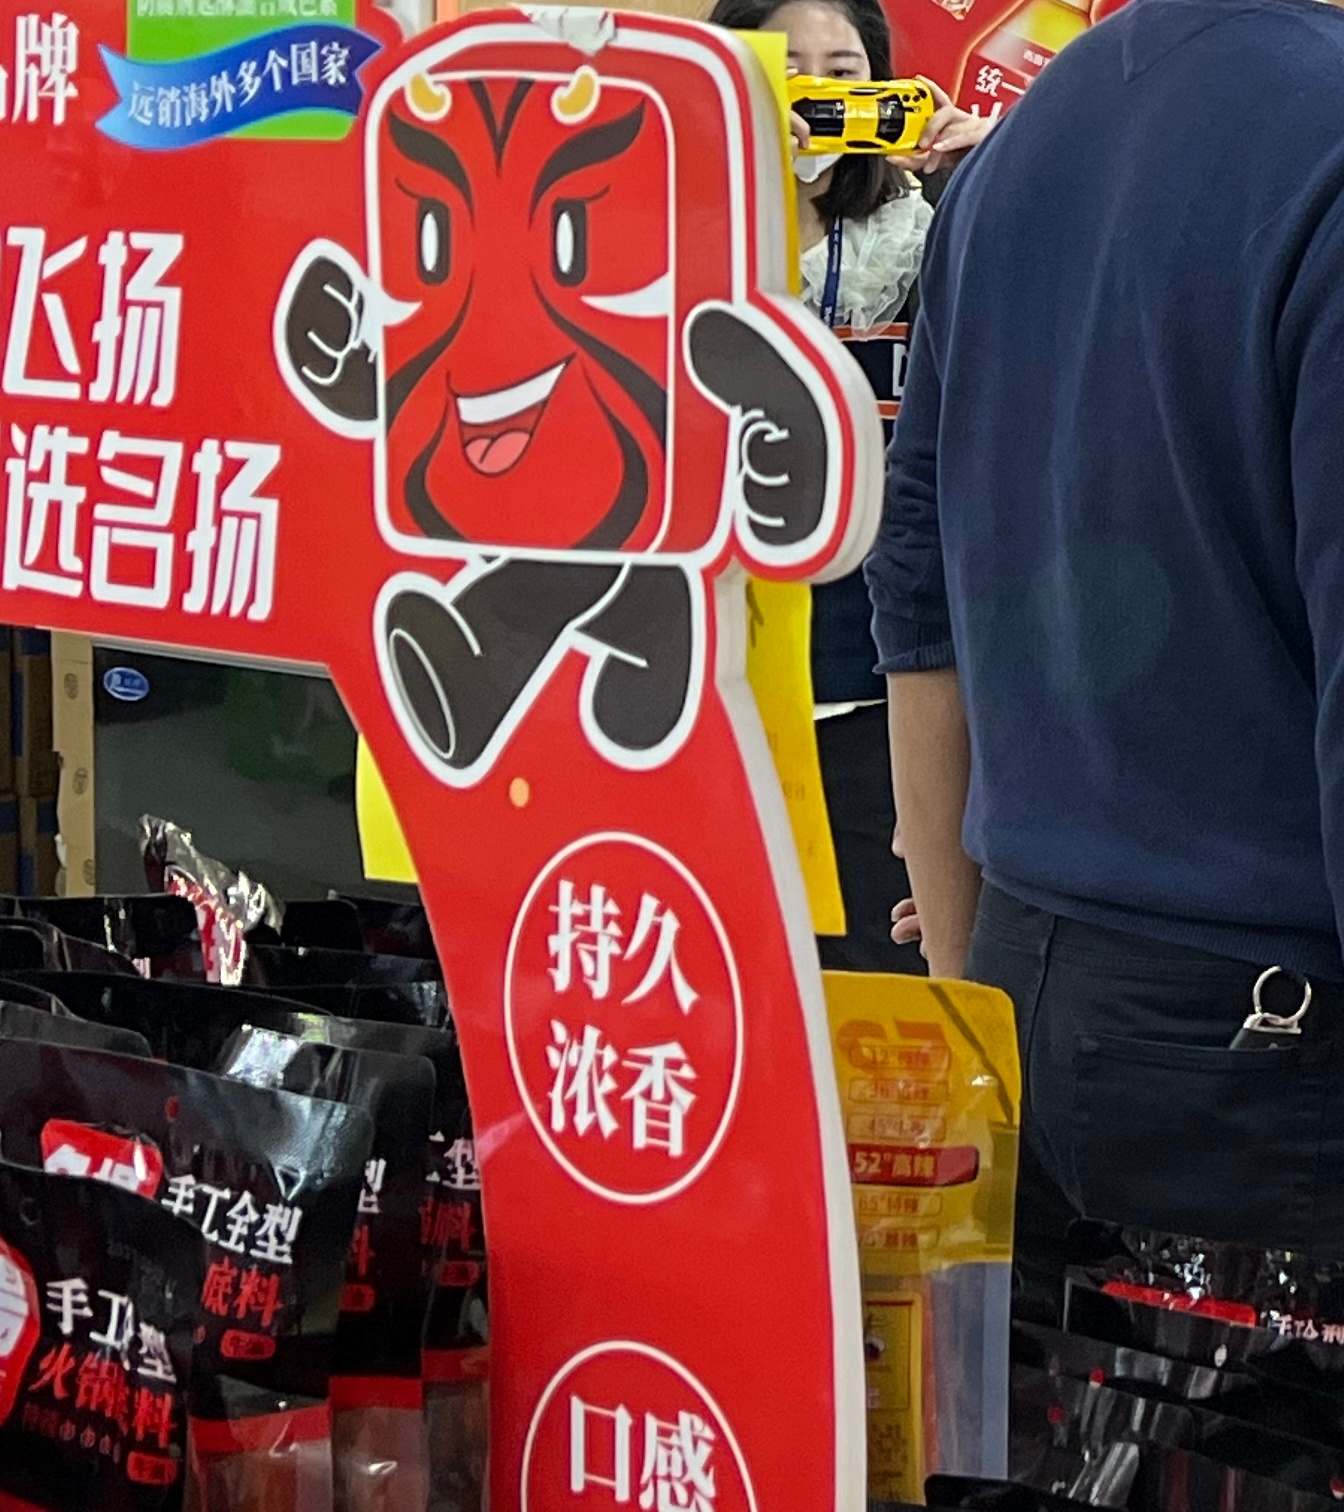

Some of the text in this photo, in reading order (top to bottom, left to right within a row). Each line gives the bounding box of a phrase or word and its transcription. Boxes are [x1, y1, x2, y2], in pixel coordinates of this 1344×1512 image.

[0, 13, 81, 127] 牌
[128, 41, 351, 128] 远销海外多个国家
[974, 64, 1027, 98] 统一
[2, 226, 185, 408] 飞扬
[2, 422, 282, 622] 选名扬
[547, 879, 700, 1015] 持久
[546, 1020, 700, 1158] 浓香
[160, 1173, 303, 1266] 手工全型
[202, 1255, 284, 1328] 底料
[570, 1394, 716, 1512] 口感
